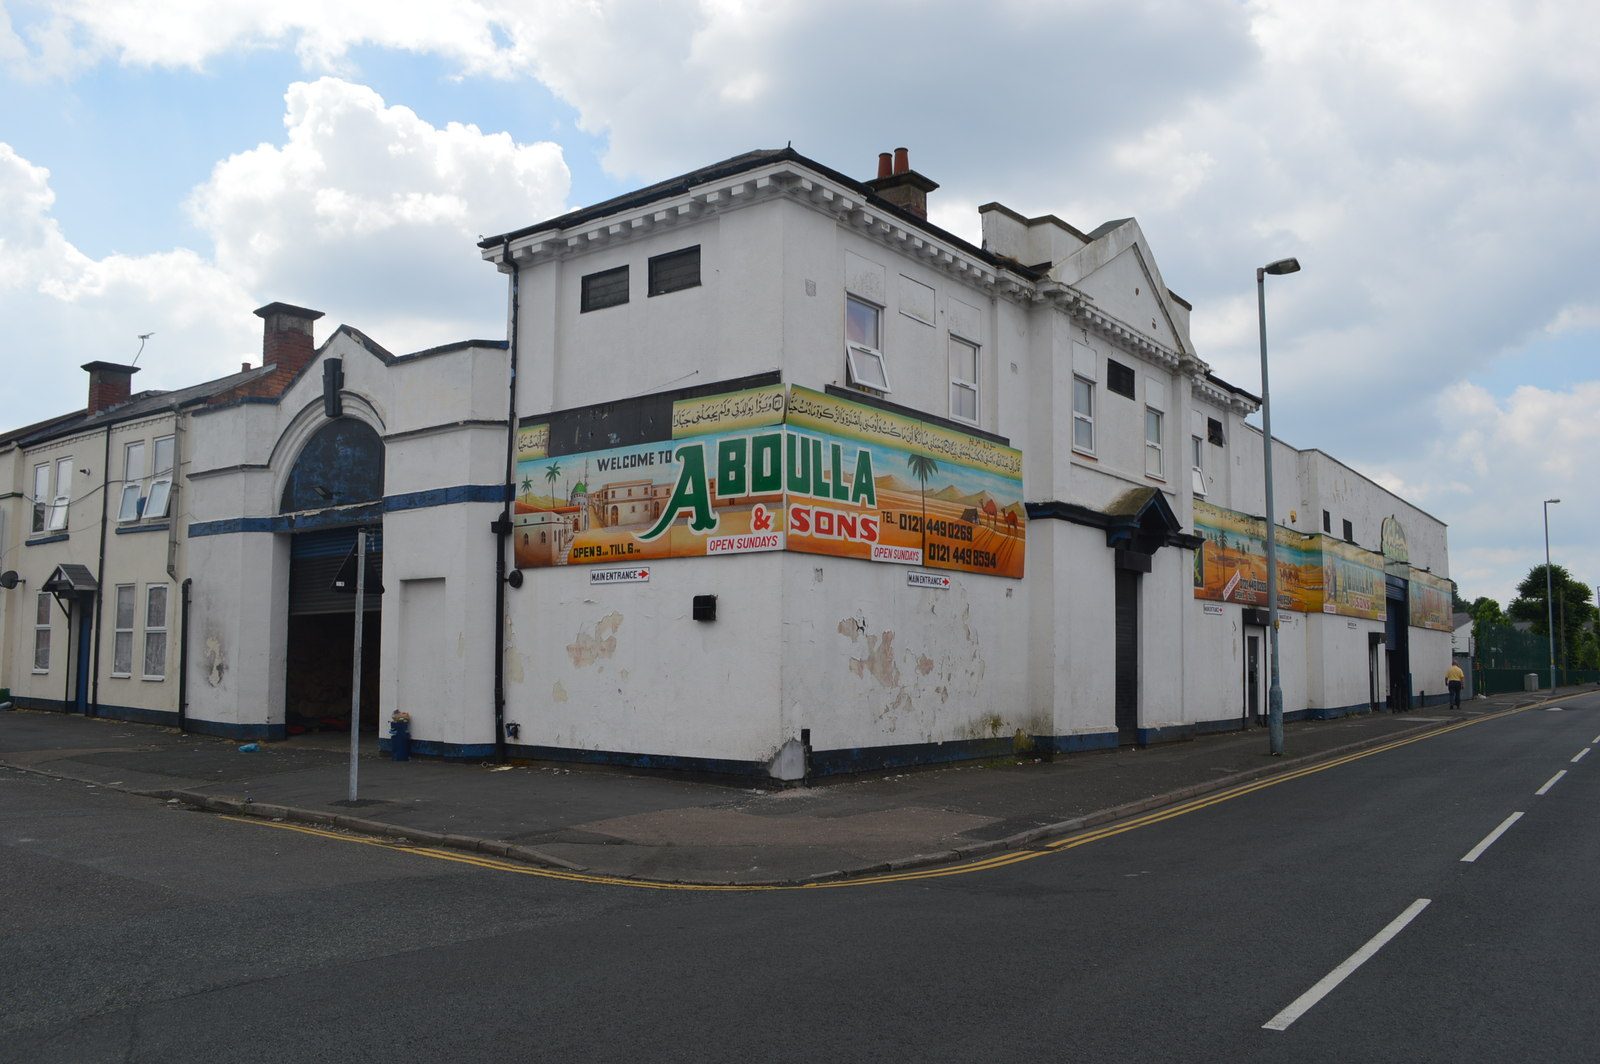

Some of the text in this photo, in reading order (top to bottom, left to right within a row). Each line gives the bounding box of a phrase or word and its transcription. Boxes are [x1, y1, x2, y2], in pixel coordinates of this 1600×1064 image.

[597, 450, 672, 472] WELCOME TO
[753, 506, 879, 542] & SONS
[900, 513, 924, 533] 0121
[926, 518, 946, 537] 449
[573, 546, 595, 559] OPEN
[610, 543, 626, 555] TILL
[709, 535, 778, 551] OPEN SUNDAYS
[874, 547, 920, 562] OPEN SUNDAYS
[929, 543, 997, 568] 0121 449 8594
[591, 570, 638, 582] MAIN ENTRANCE
[908, 573, 942, 586] MAIN ENTRANCE
